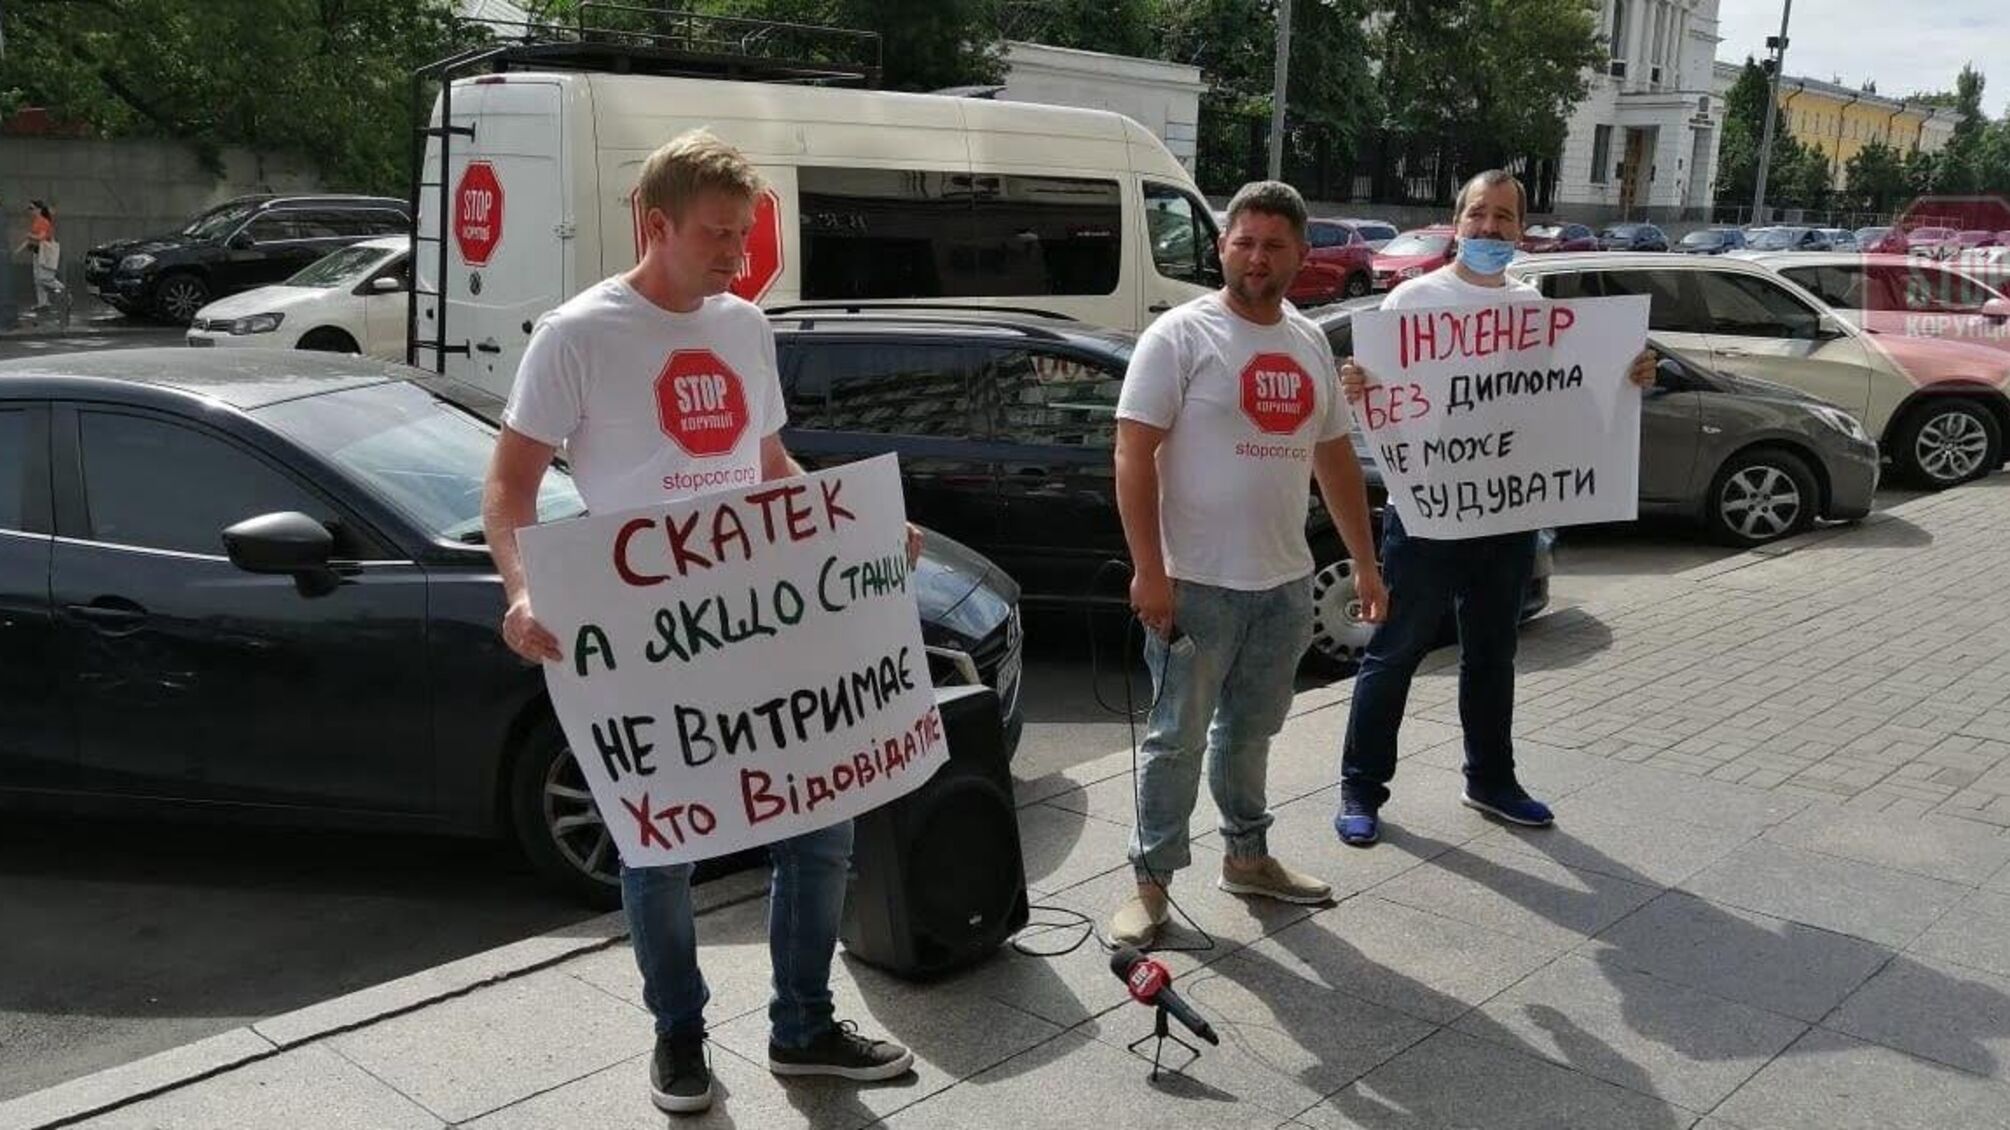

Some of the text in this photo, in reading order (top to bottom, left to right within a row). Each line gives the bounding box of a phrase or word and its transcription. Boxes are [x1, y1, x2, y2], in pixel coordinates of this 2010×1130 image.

[463, 189, 493, 223] STOP
[1400, 306, 1576, 368] ІНЖЕНЕР
[673, 374, 728, 413] STOP
[1255, 370, 1302, 400] STOP
[1363, 365, 1583, 431] БЕЗ ДИПЛОМА
[662, 467, 756, 491] stopcor.org
[1381, 431, 1515, 474] НЕ МОЖЕ
[1410, 468, 1596, 522] БУДУВАТИ
[613, 479, 856, 586] СКАТЕК
[574, 624, 617, 677] А
[645, 580, 805, 663] ЯКЩО
[592, 715, 656, 782] НЕ
[674, 646, 915, 767] ВИТРИМАЄ
